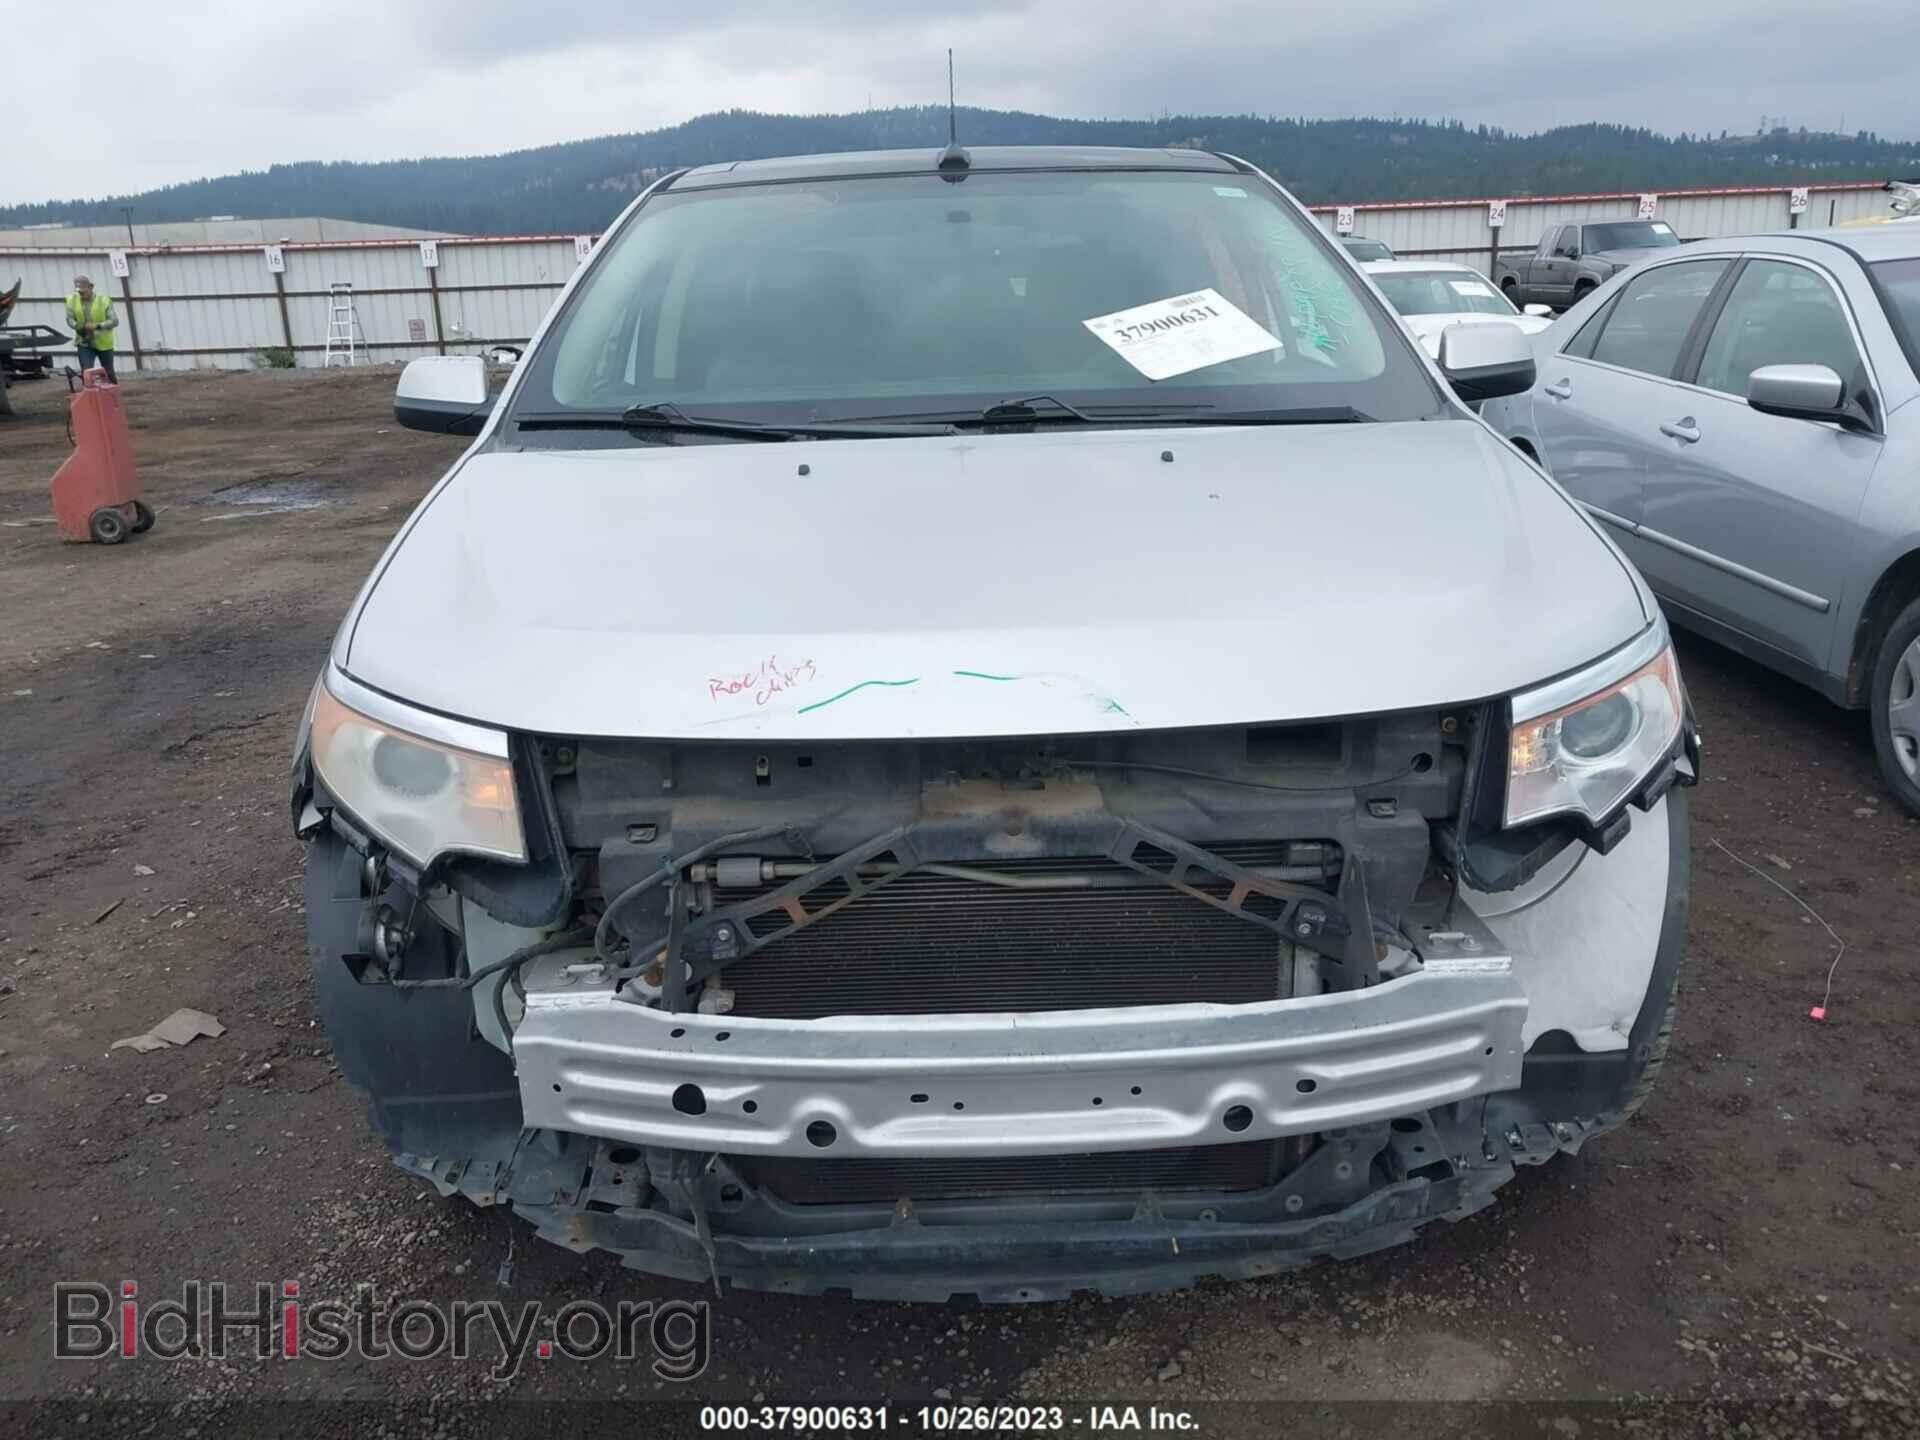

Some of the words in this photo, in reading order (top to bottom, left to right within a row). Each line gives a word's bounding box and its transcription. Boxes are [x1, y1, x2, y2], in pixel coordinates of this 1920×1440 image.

[1640, 200, 1656, 213] 25
[1791, 194, 1808, 207] 26
[1490, 207, 1504, 220] 24
[1339, 214, 1352, 226] 23
[423, 248, 434, 260] 17
[578, 243, 590, 255] 18
[113, 258, 126, 270] 15
[269, 253, 281, 265] 16
[1113, 304, 1220, 343] 37900631
